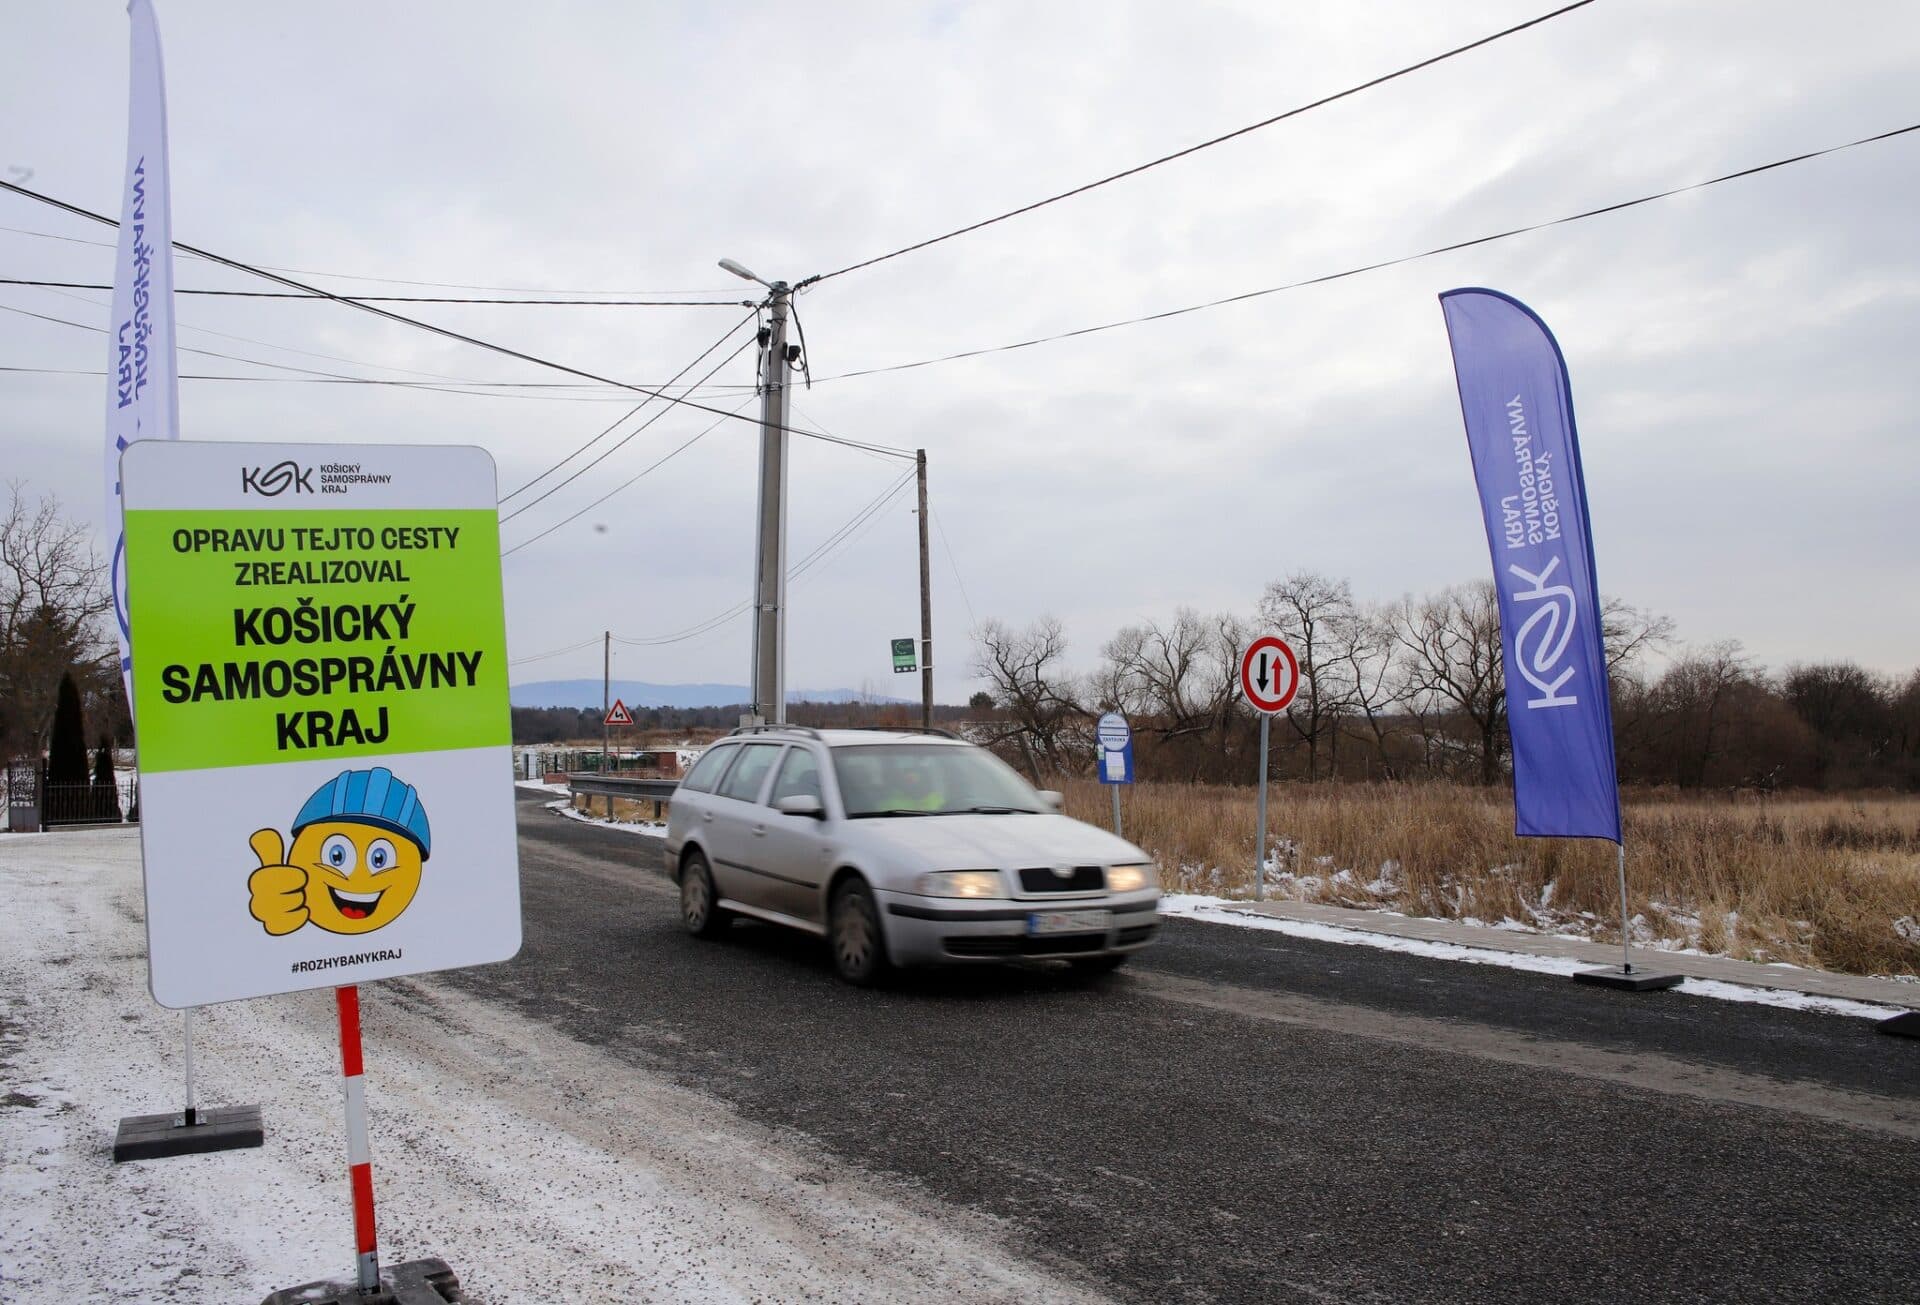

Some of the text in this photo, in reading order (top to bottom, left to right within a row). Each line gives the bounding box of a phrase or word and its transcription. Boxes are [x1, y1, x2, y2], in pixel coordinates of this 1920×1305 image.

[242, 460, 315, 497] KSK
[320, 463, 361, 474] KOŠICKÝ
[320, 473, 392, 484] SAMOSPRÁVNY
[321, 484, 348, 494] KRAJ
[172, 527, 460, 553] OPRAVU TEJTO CESTY
[234, 559, 410, 586] ZREALIZOVAL
[233, 594, 416, 647] KOŠICKÝ
[161, 646, 483, 704] SAMOSPRÁVNY
[276, 706, 389, 751] KRAJ
[291, 948, 402, 973] #ROZHYBANYKRAJ
